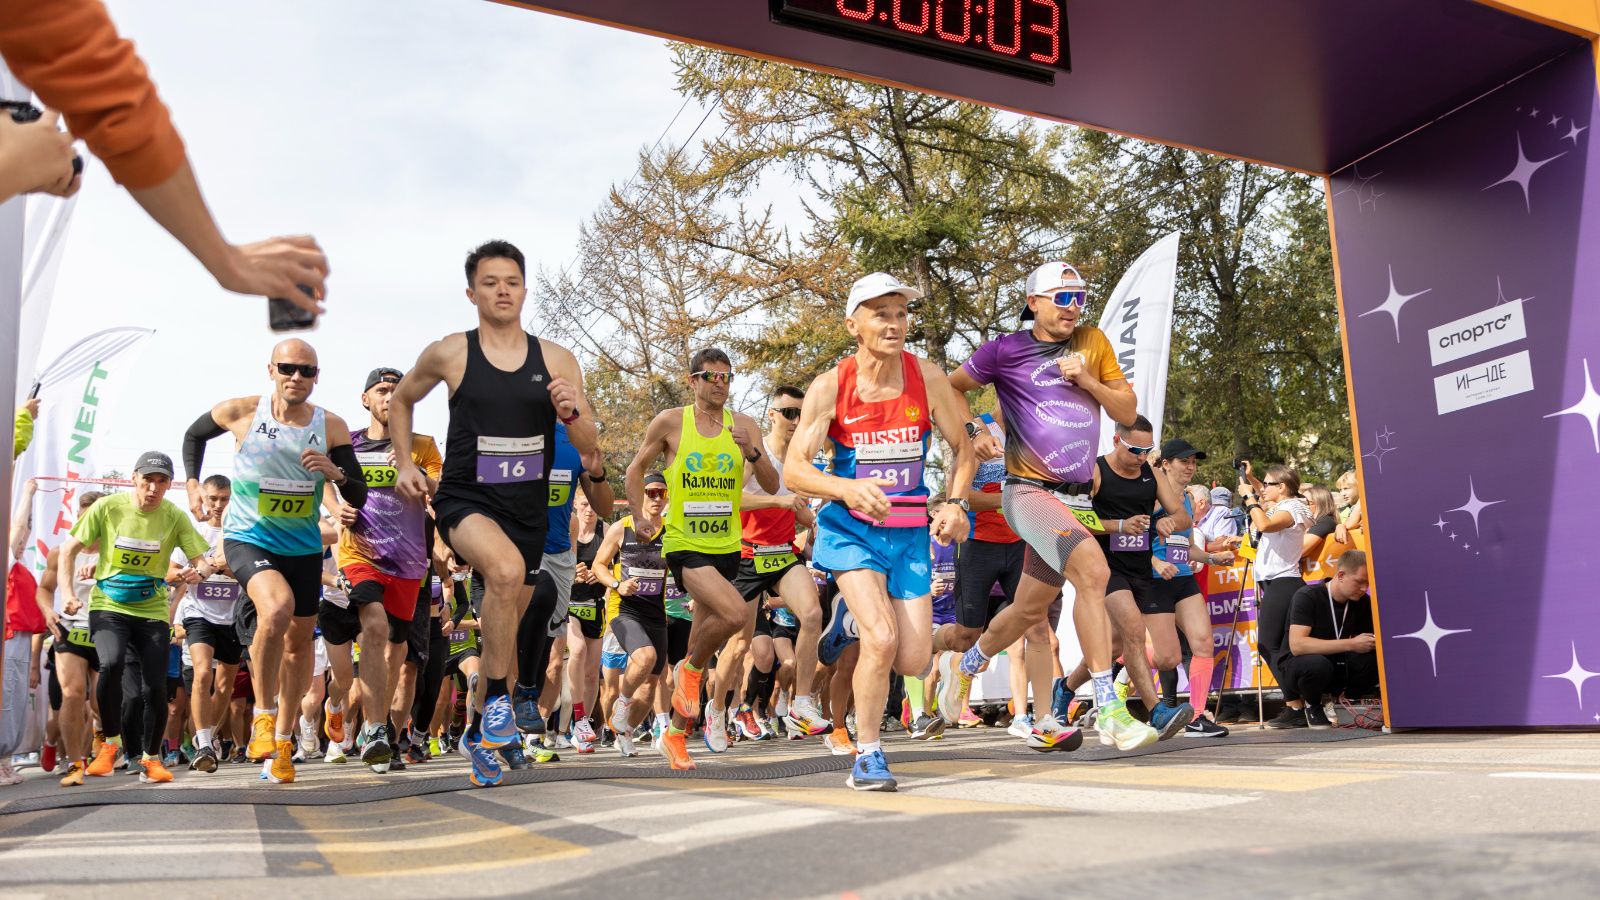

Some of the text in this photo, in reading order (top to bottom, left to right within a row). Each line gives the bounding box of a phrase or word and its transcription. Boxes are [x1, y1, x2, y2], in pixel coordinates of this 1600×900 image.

[1117, 296, 1141, 383] MAN
[256, 422, 280, 440] Ag
[852, 425, 920, 445] RUSSIA
[364, 469, 395, 483] 639
[498, 460, 526, 478] 16
[682, 472, 735, 490] Камелот
[270, 498, 305, 513] 707
[688, 520, 729, 534] 1064
[1118, 535, 1144, 548] 325
[120, 553, 151, 567] 567
[1173, 549, 1188, 561] 273
[204, 586, 231, 598] 332
[943, 582, 954, 591] 75
[573, 608, 592, 618] 763
[73, 631, 95, 643] 11
